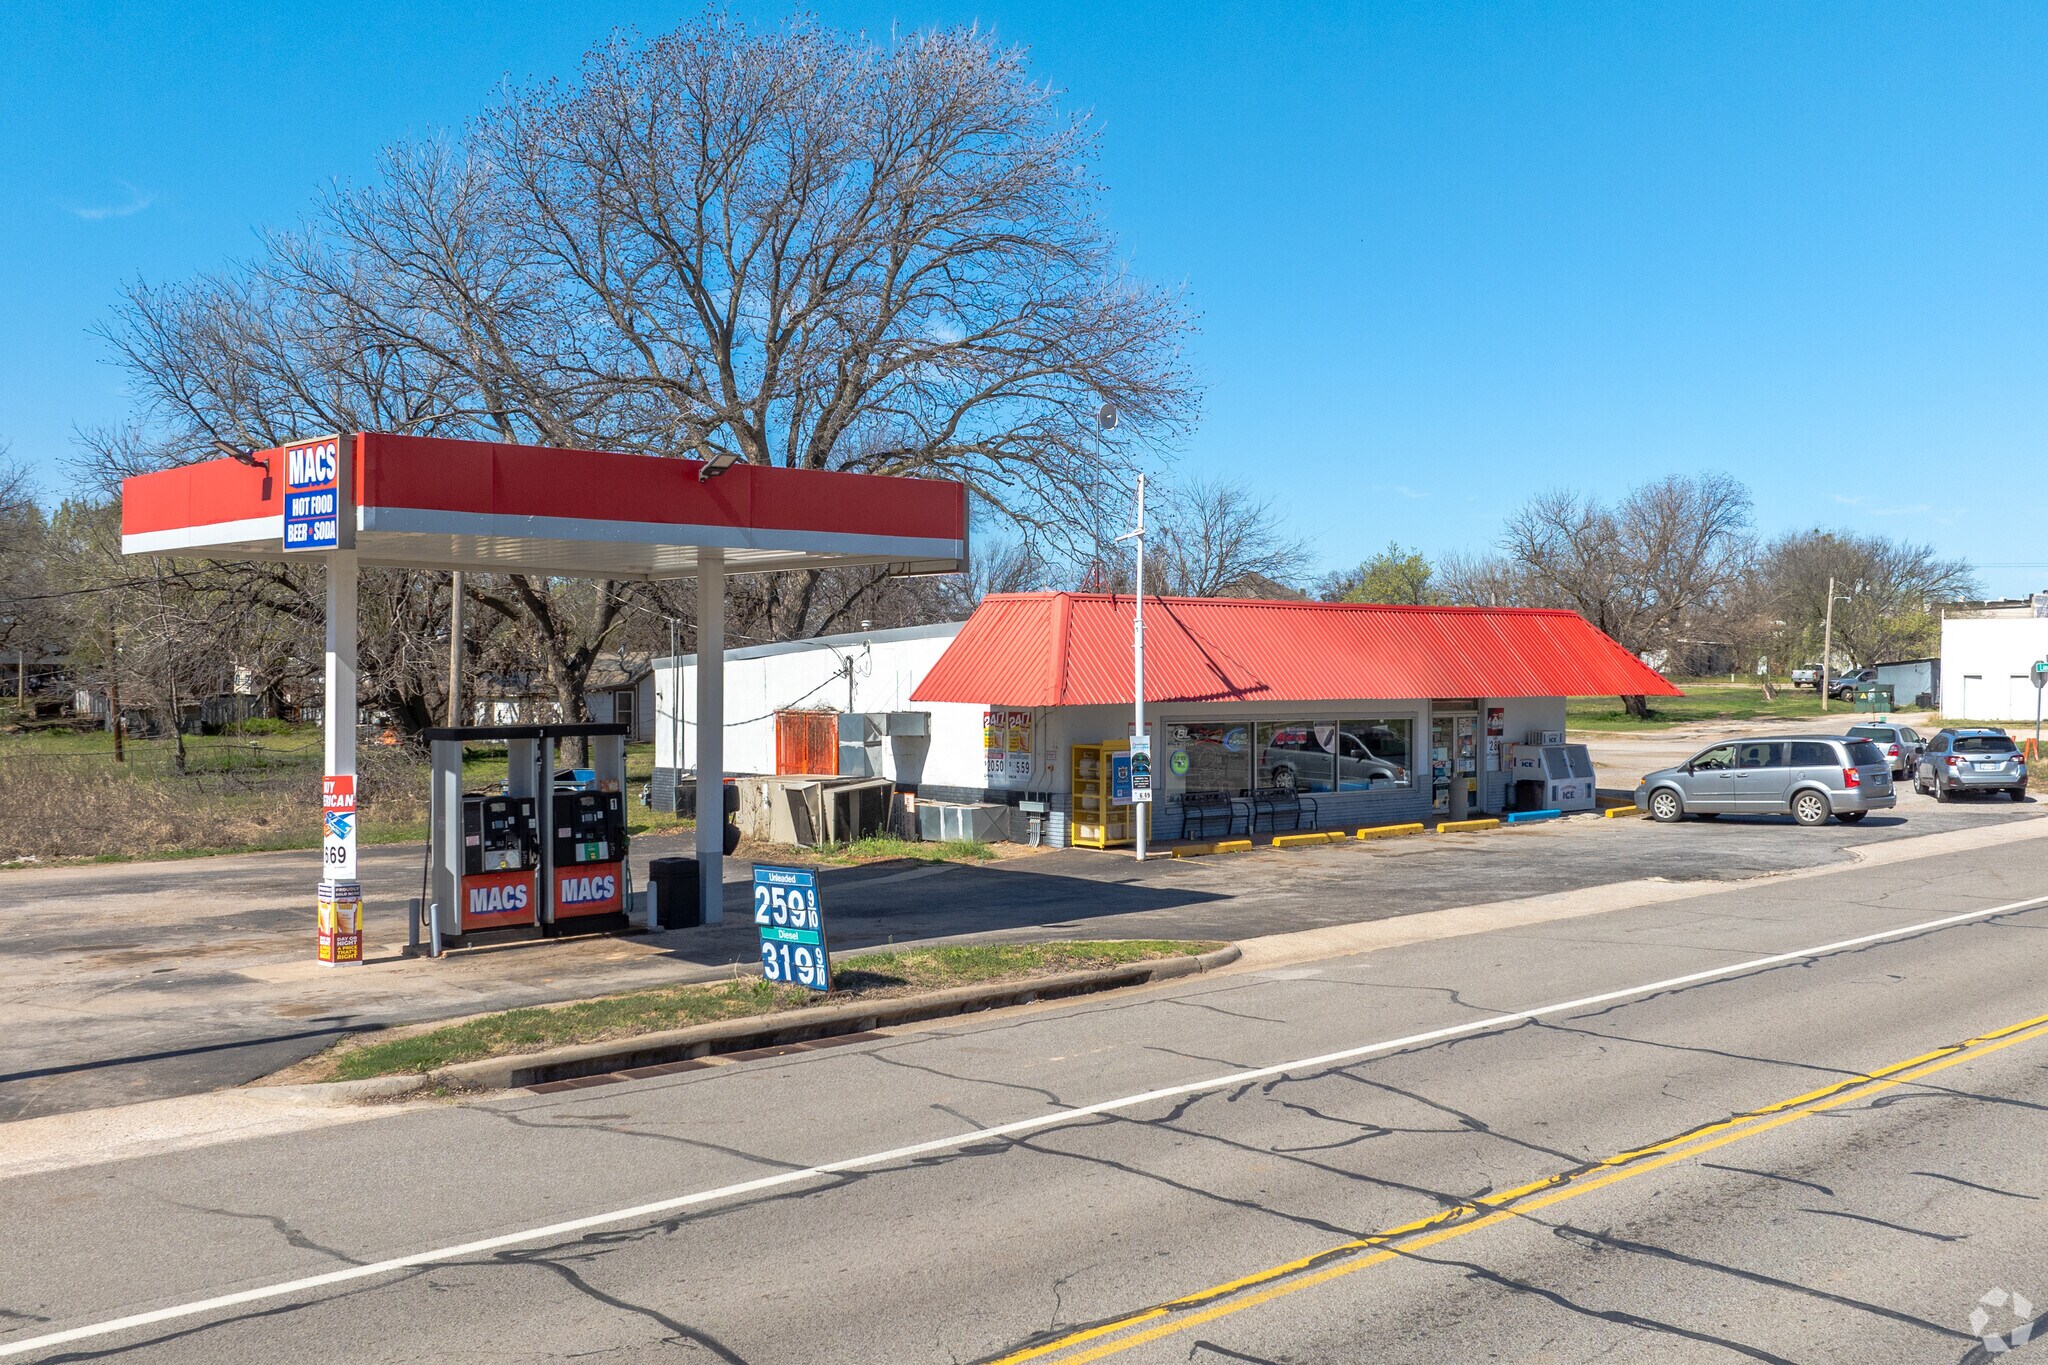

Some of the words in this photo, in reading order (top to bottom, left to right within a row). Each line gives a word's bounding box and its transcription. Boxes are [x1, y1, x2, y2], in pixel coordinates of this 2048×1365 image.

[288, 443, 337, 485] MACS
[292, 498, 310, 517] HOT
[311, 494, 333, 514] FOOD
[287, 523, 308, 542] BEER
[313, 520, 336, 540] SODA
[1016, 761, 1030, 774] 5.59
[1562, 791, 1576, 800] ICE
[561, 875, 615, 903] MACS
[769, 873, 796, 883] Unleaded
[470, 884, 527, 913] MACS
[778, 930, 799, 941] Diesel
